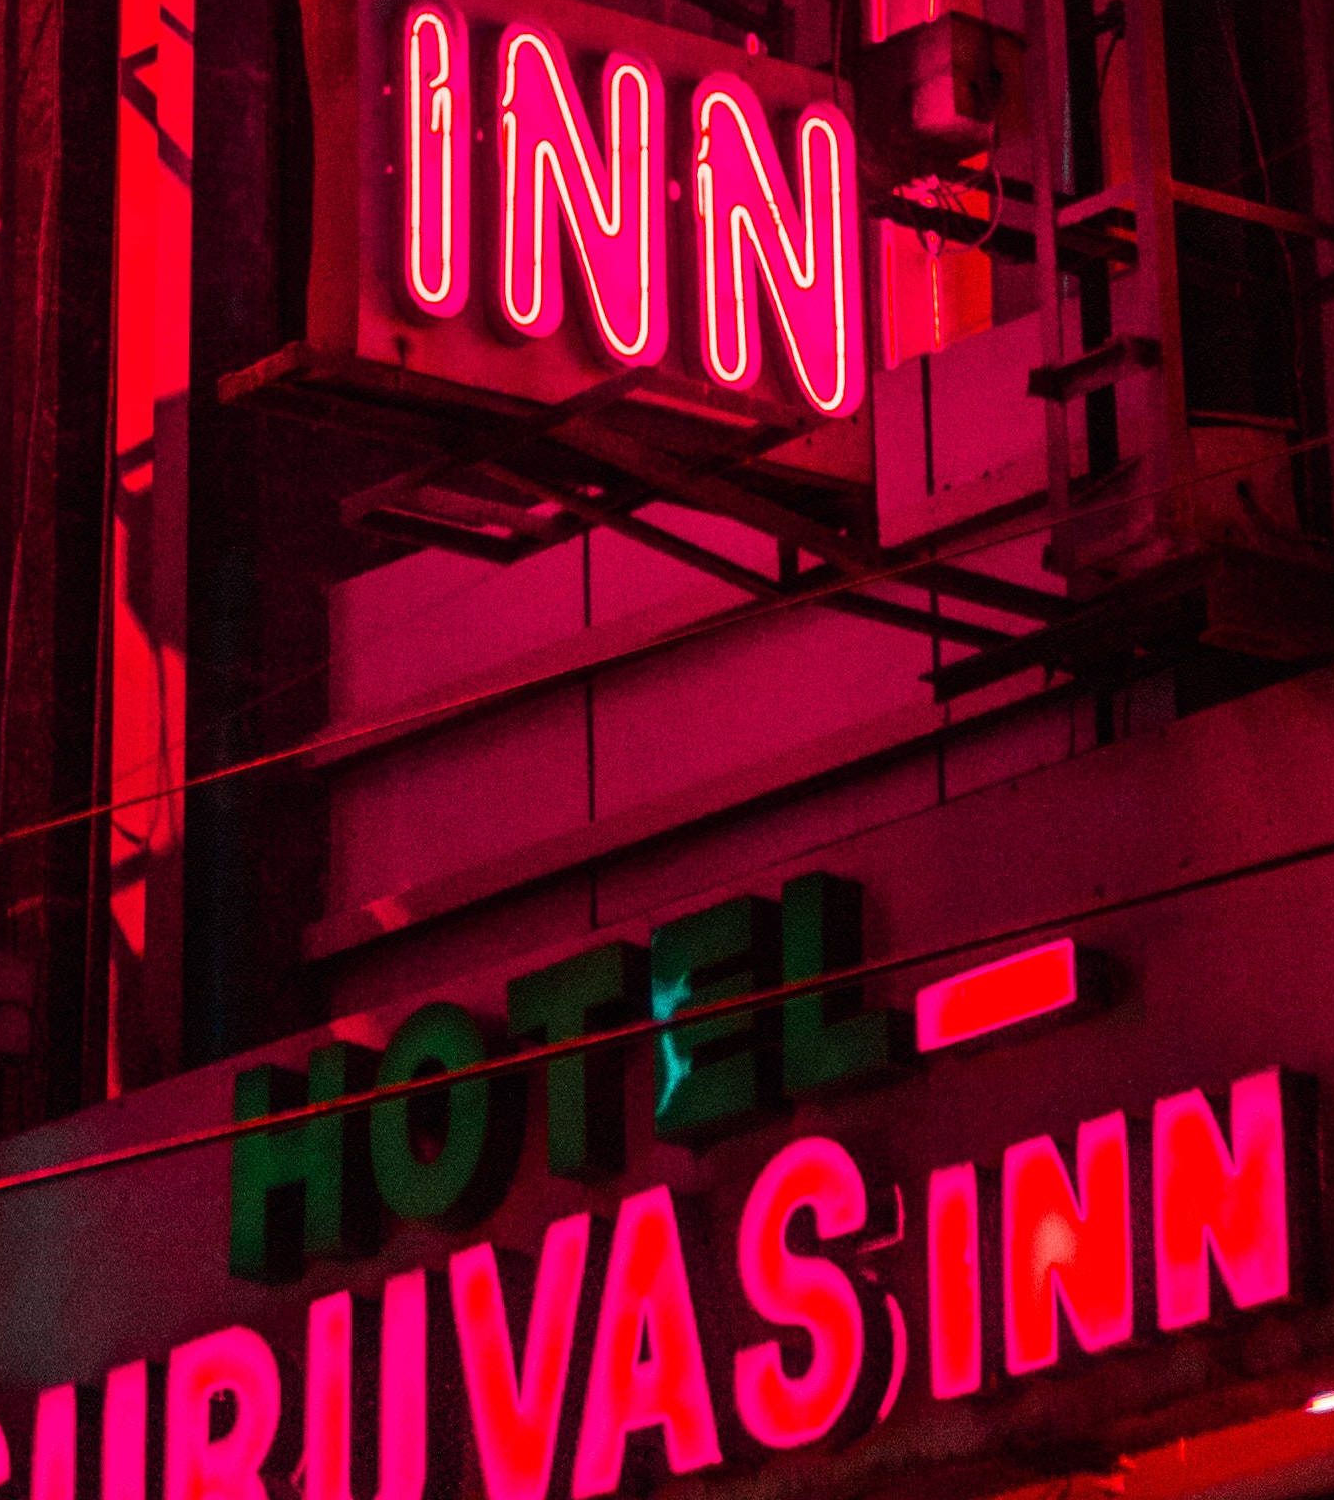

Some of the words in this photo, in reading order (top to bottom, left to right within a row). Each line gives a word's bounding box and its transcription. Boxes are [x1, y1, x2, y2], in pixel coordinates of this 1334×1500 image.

[405, 0, 865, 418] INN
[227, 868, 891, 1284] HOTEL
[925, 1064, 1291, 1402] INN
